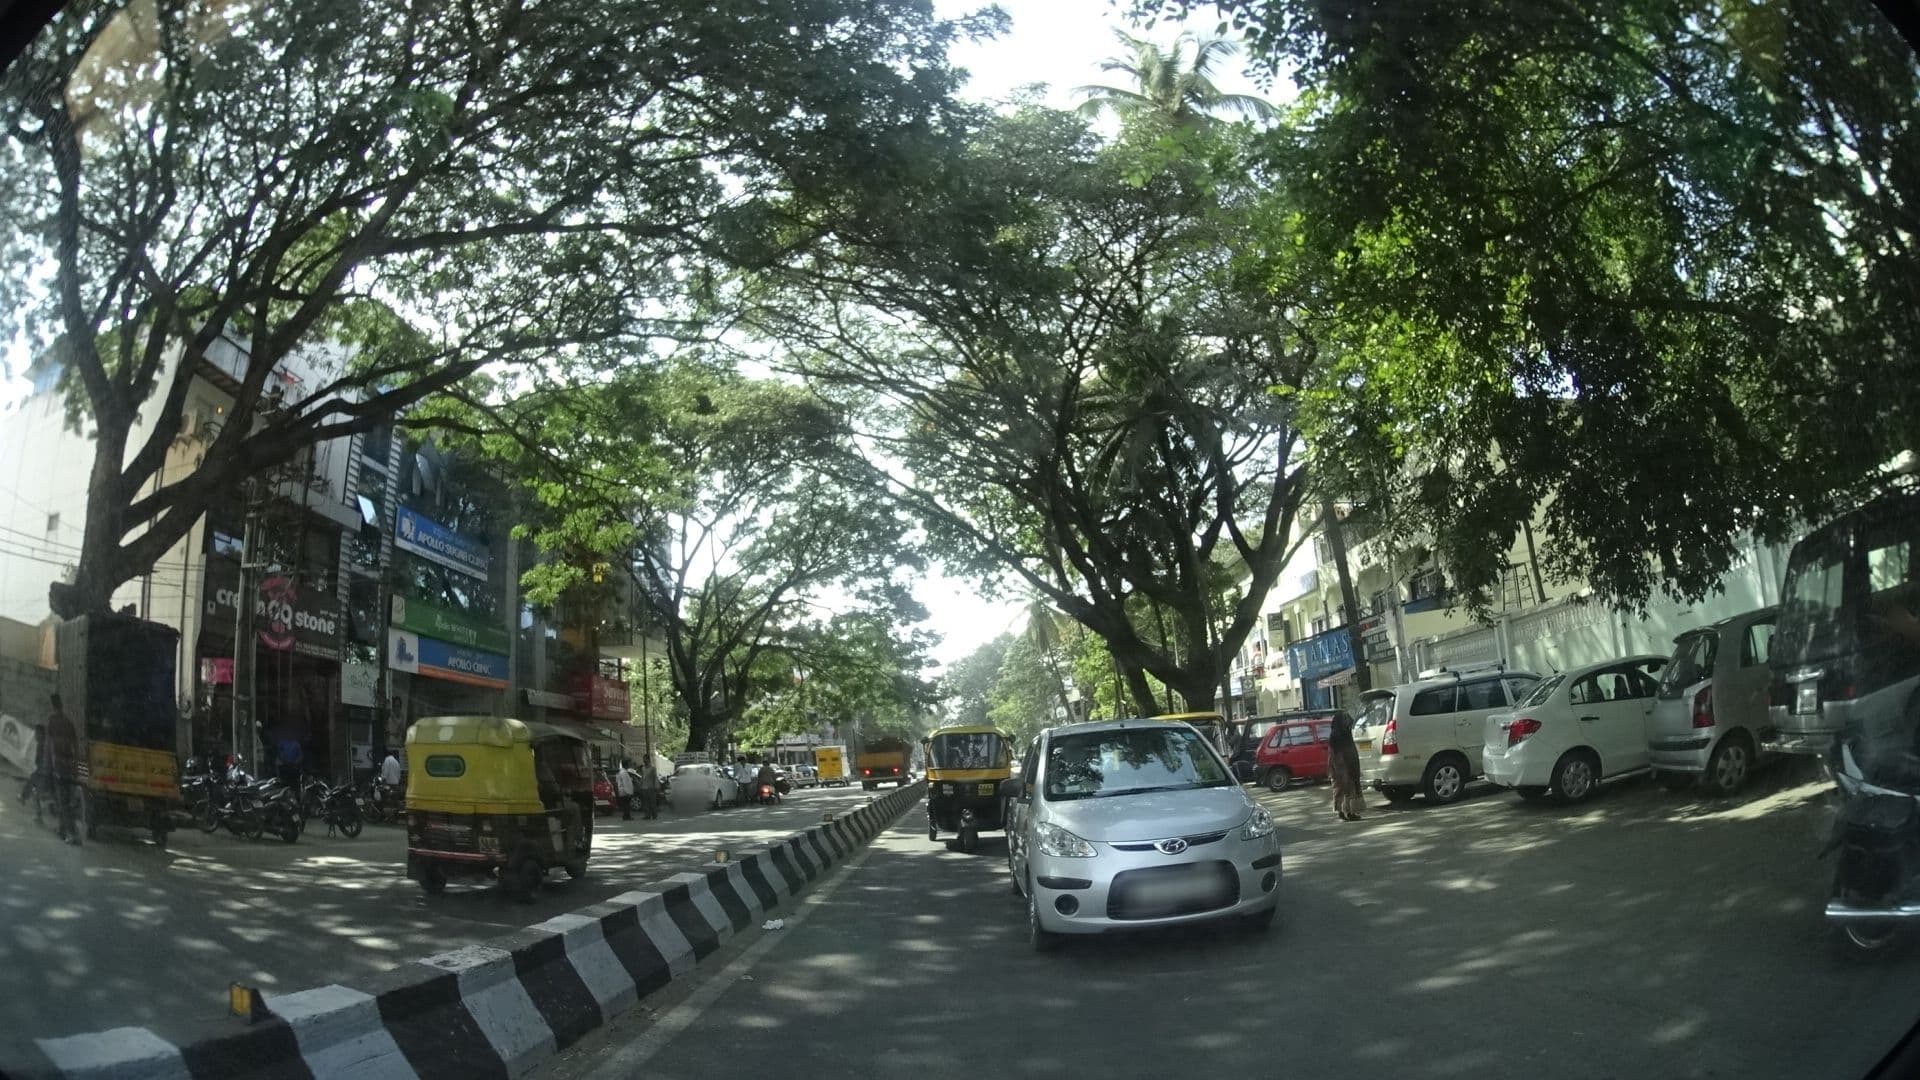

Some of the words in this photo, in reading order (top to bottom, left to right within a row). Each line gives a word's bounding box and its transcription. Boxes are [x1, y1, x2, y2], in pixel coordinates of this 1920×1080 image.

[417, 530, 444, 552] APOLLO
[295, 611, 336, 636] stone
[1311, 634, 1349, 661] ATLAS
[448, 655, 471, 671] APOLLO
